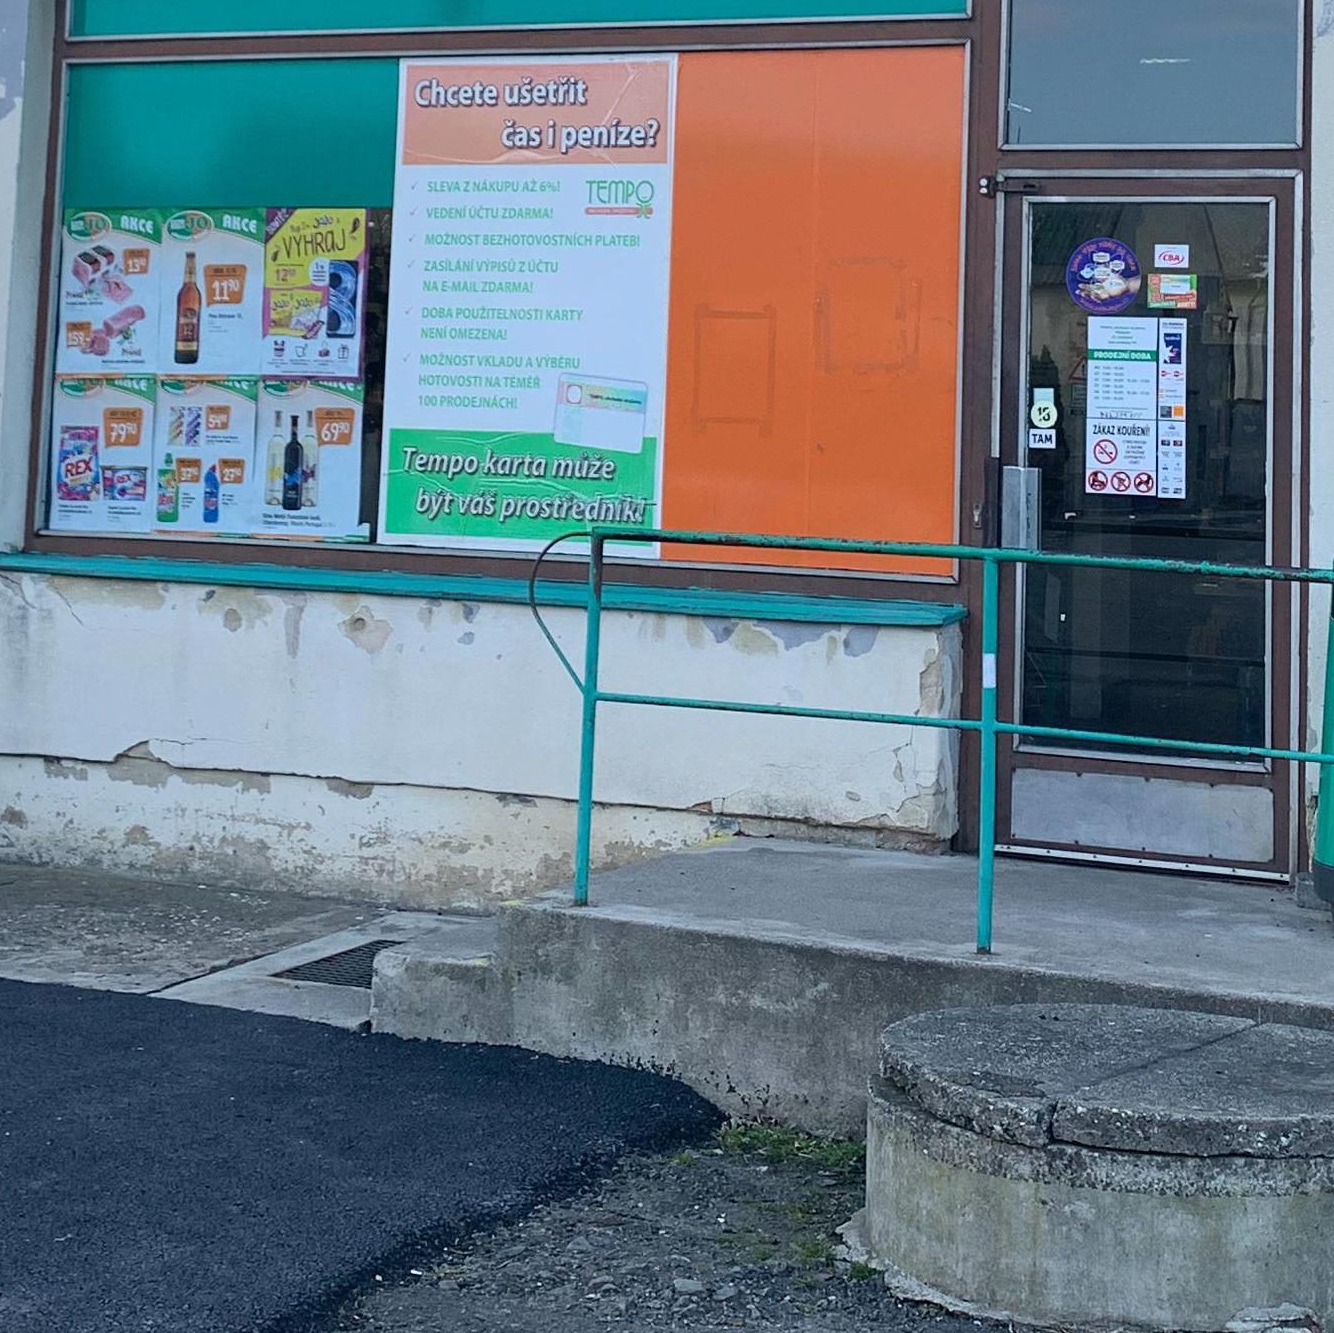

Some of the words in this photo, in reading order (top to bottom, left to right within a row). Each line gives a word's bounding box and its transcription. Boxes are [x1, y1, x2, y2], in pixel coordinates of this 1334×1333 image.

[414, 77, 499, 107] Chcete
[504, 76, 588, 106] ušetřit
[501, 118, 543, 148] čas
[547, 119, 555, 148] i
[560, 117, 660, 154] peníze?
[426, 180, 463, 193] SLEVA
[463, 181, 471, 192] Z
[472, 179, 520, 193] NÁKUPU
[522, 179, 538, 193] AŽ
[585, 180, 655, 204] TEMPO
[425, 205, 467, 219] VEDENÍ
[467, 205, 501, 220] ÚČTU
[501, 207, 554, 220] ZDARMA!
[120, 214, 154, 234] AKCE
[222, 214, 258, 234] AKCE
[424, 232, 481, 246] MOŽNOST
[482, 232, 593, 247] BEZHOTOVOSTNÍCH
[594, 234, 640, 247] PLATEB!
[423, 258, 476, 272] ZASÍLÁNÍ
[476, 258, 516, 273] VÝPISŮ
[518, 261, 526, 273] Z
[527, 259, 559, 273] ÚČTU
[422, 280, 439, 293] NA
[440, 280, 480, 293] E-MAIL
[480, 281, 534, 294] ZDARMA!
[421, 306, 454, 319] DOBA
[455, 306, 544, 320] POUŽITELNOSTI
[545, 308, 584, 321] KARTY
[420, 326, 447, 339] NENÍ
[449, 328, 508, 341] OMEZENA!
[419, 352, 476, 366] MOŽNOST
[477, 356, 524, 368] VKLADU
[525, 357, 534, 368] A
[535, 355, 581, 369] VÝBĚRU
[1094, 350, 1130, 359] PRODEJNÍ
[1130, 352, 1152, 360] DOBA
[418, 374, 484, 387] HOTOVOSTI
[484, 376, 502, 388] NA
[418, 395, 438, 407] 100
[438, 394, 518, 409] PRODEJNÁCH!
[1093, 423, 1115, 435] ZÁKAZ
[1117, 423, 1150, 436] KOUŘENÍ!
[1032, 434, 1053, 444] TAM
[65, 457, 93, 477] REX
[402, 446, 478, 480] Tempo
[483, 447, 545, 478] karta
[551, 451, 616, 480] může
[416, 486, 453, 520] být
[458, 487, 497, 516] váš
[499, 492, 646, 524] prostředník!
